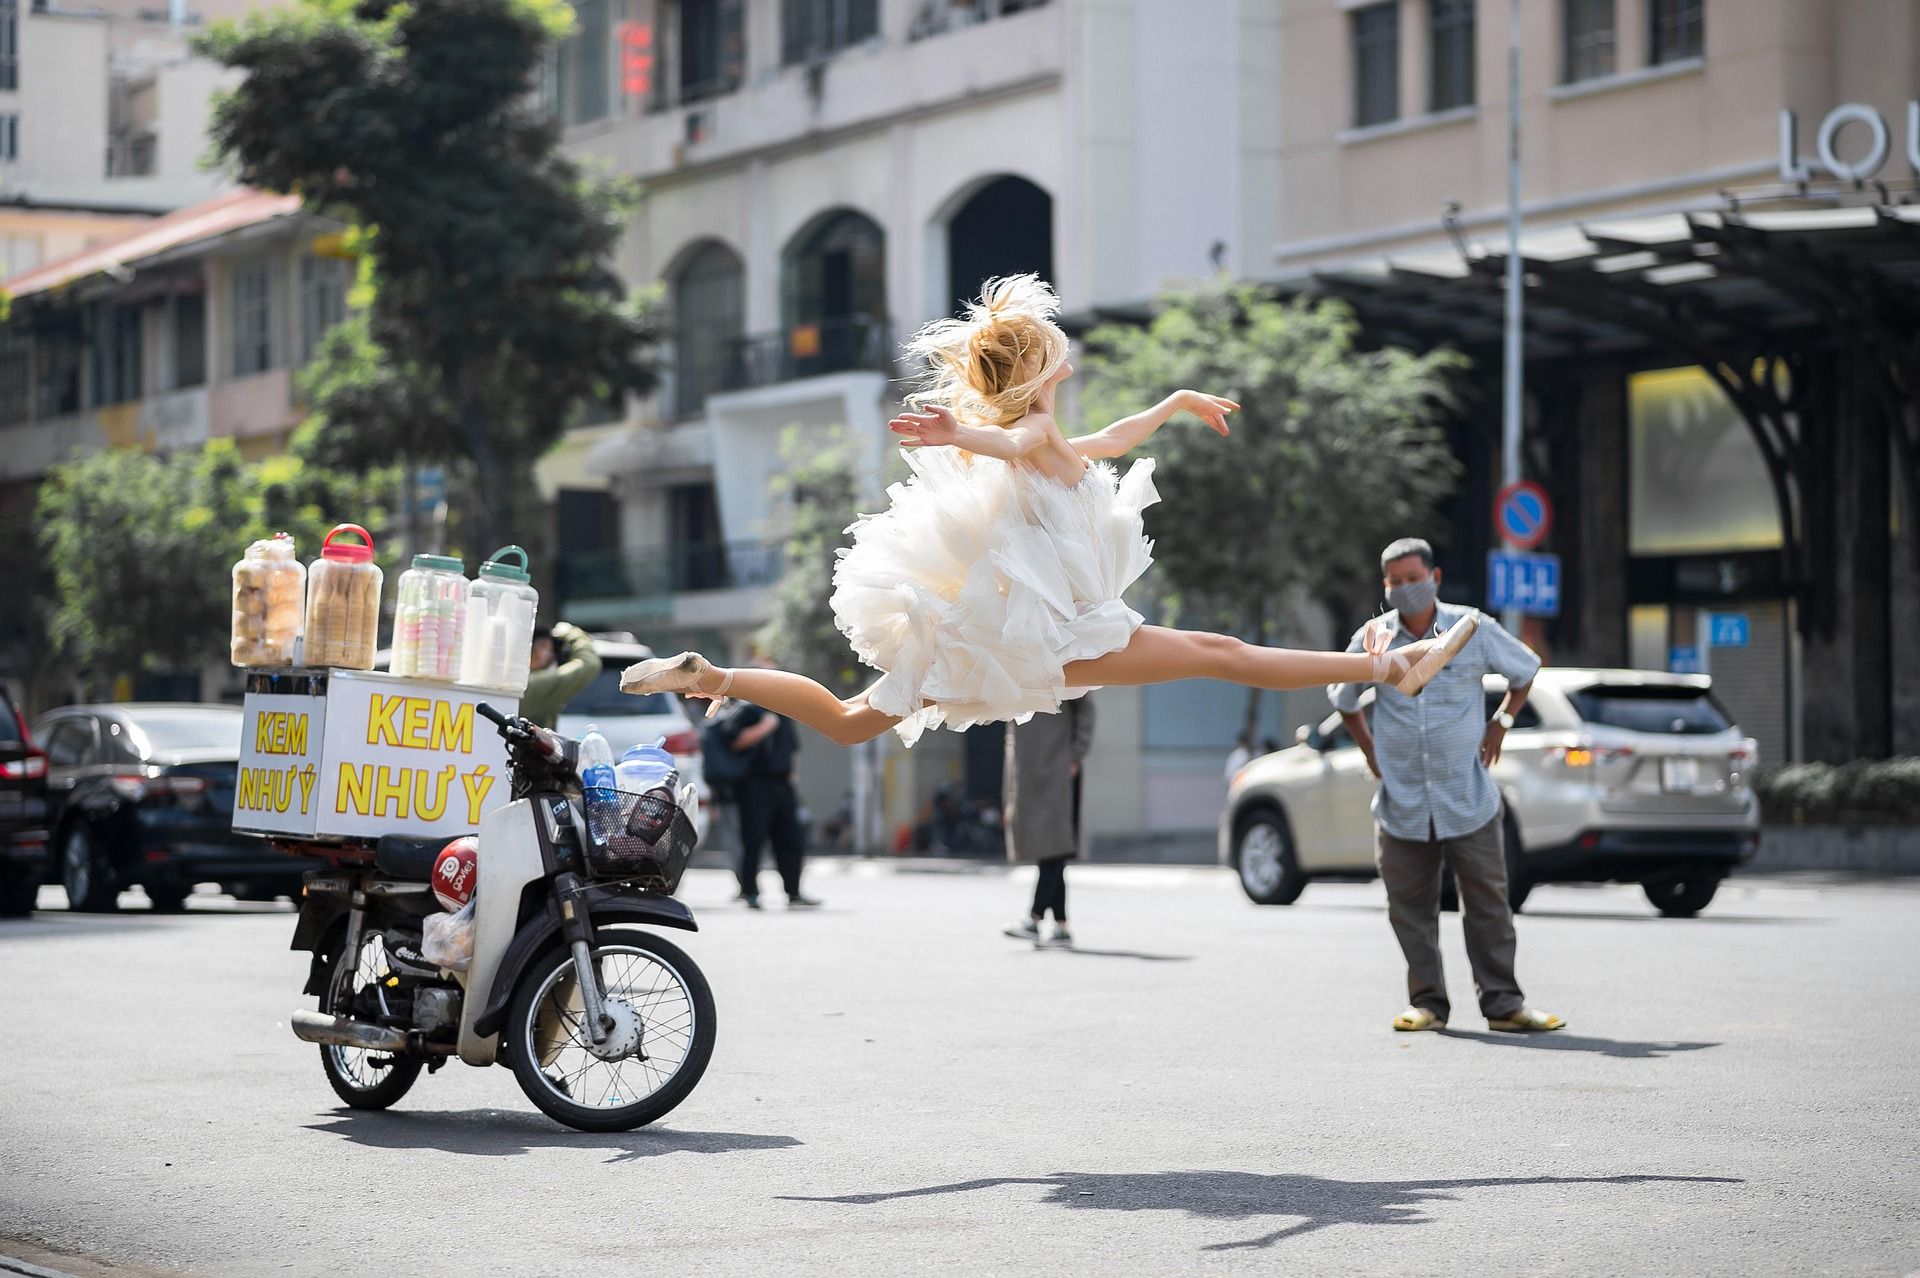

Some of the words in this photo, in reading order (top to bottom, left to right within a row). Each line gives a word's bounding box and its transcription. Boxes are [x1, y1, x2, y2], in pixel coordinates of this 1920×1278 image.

[1778, 101, 1920, 182] LO
[255, 711, 309, 756] KEM
[367, 693, 475, 754] KEM
[238, 763, 297, 813] NHƯ
[299, 763, 317, 815] Ý
[336, 761, 456, 822] NHƯ
[461, 764, 496, 825] Ý
